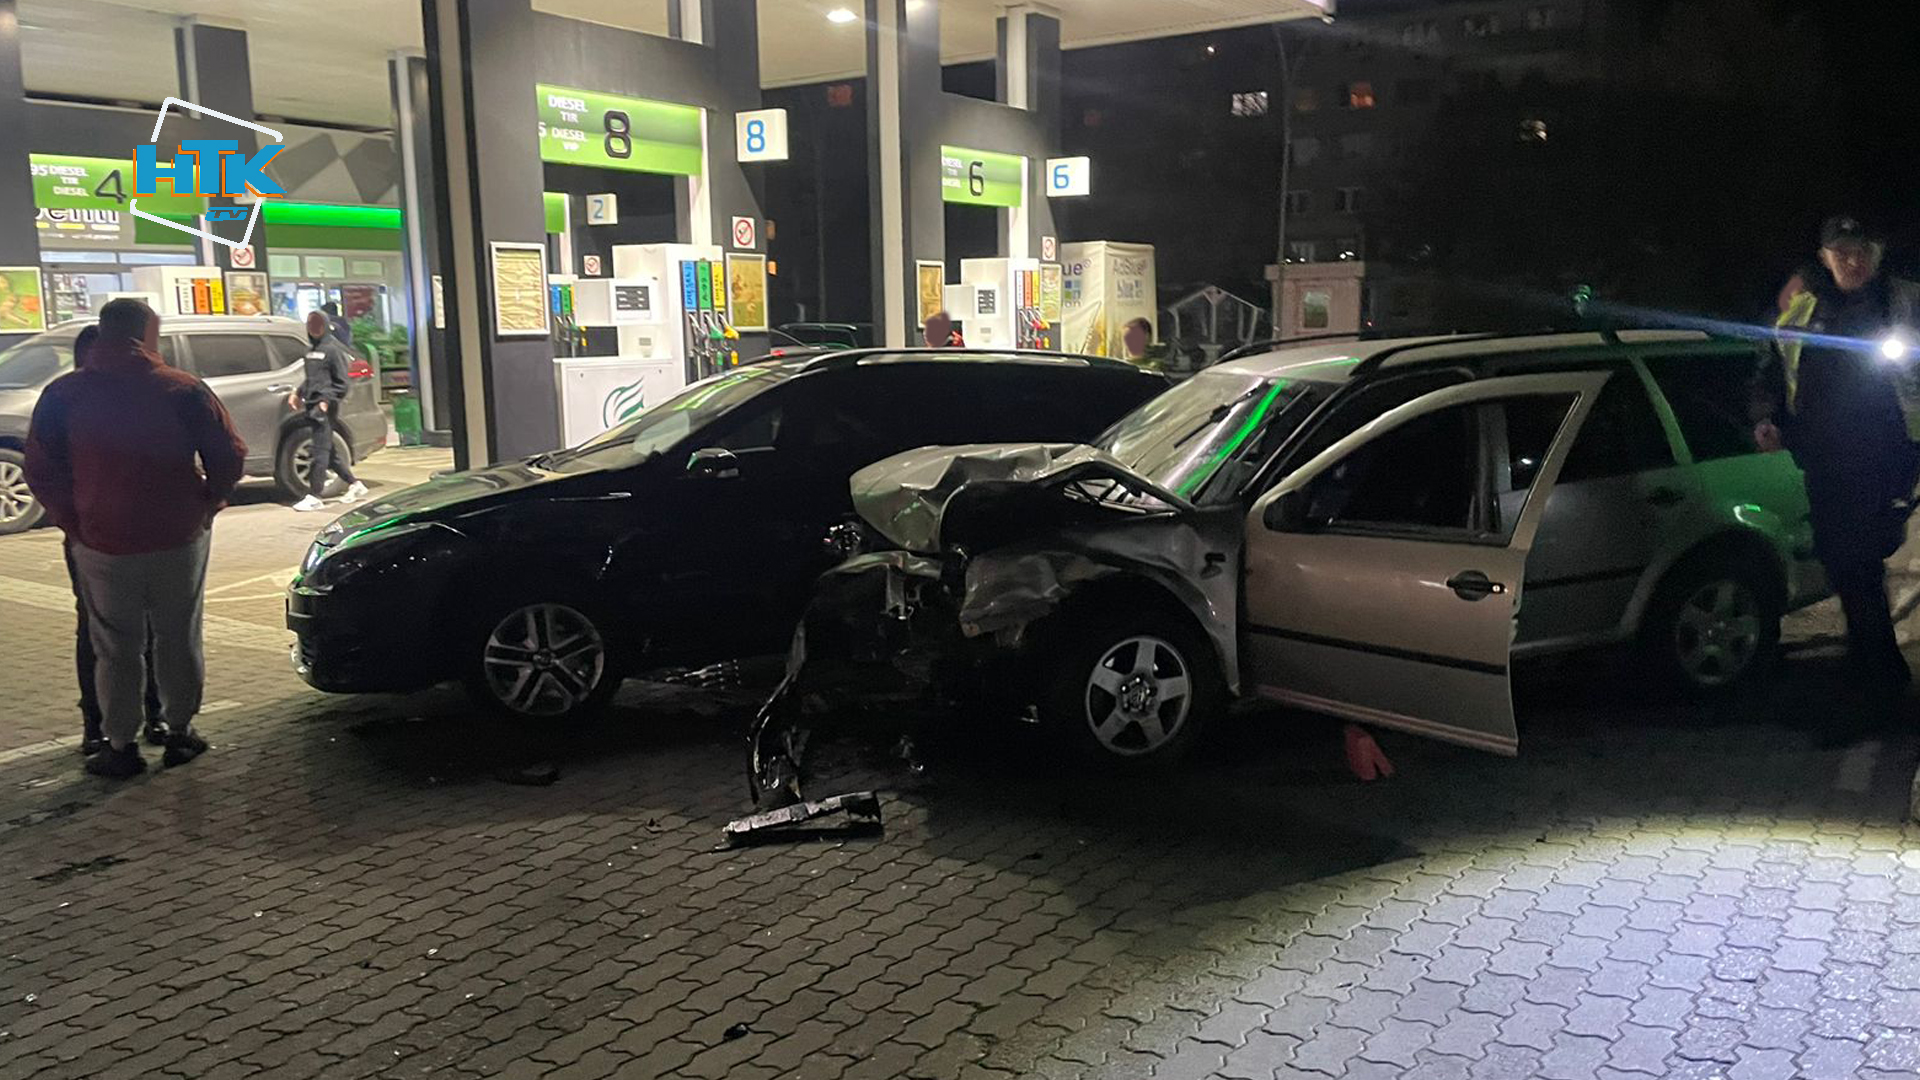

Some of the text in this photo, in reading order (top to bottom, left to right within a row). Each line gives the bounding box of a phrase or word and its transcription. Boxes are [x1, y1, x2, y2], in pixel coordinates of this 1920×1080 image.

[547, 94, 588, 113] DIESEL
[551, 127, 588, 142] DIESEL
[603, 109, 632, 160] 8
[746, 119, 765, 153] 8
[94, 169, 127, 204] 4
[969, 161, 985, 197] 6
[1053, 164, 1070, 189] 6
[593, 199, 604, 219] 2
